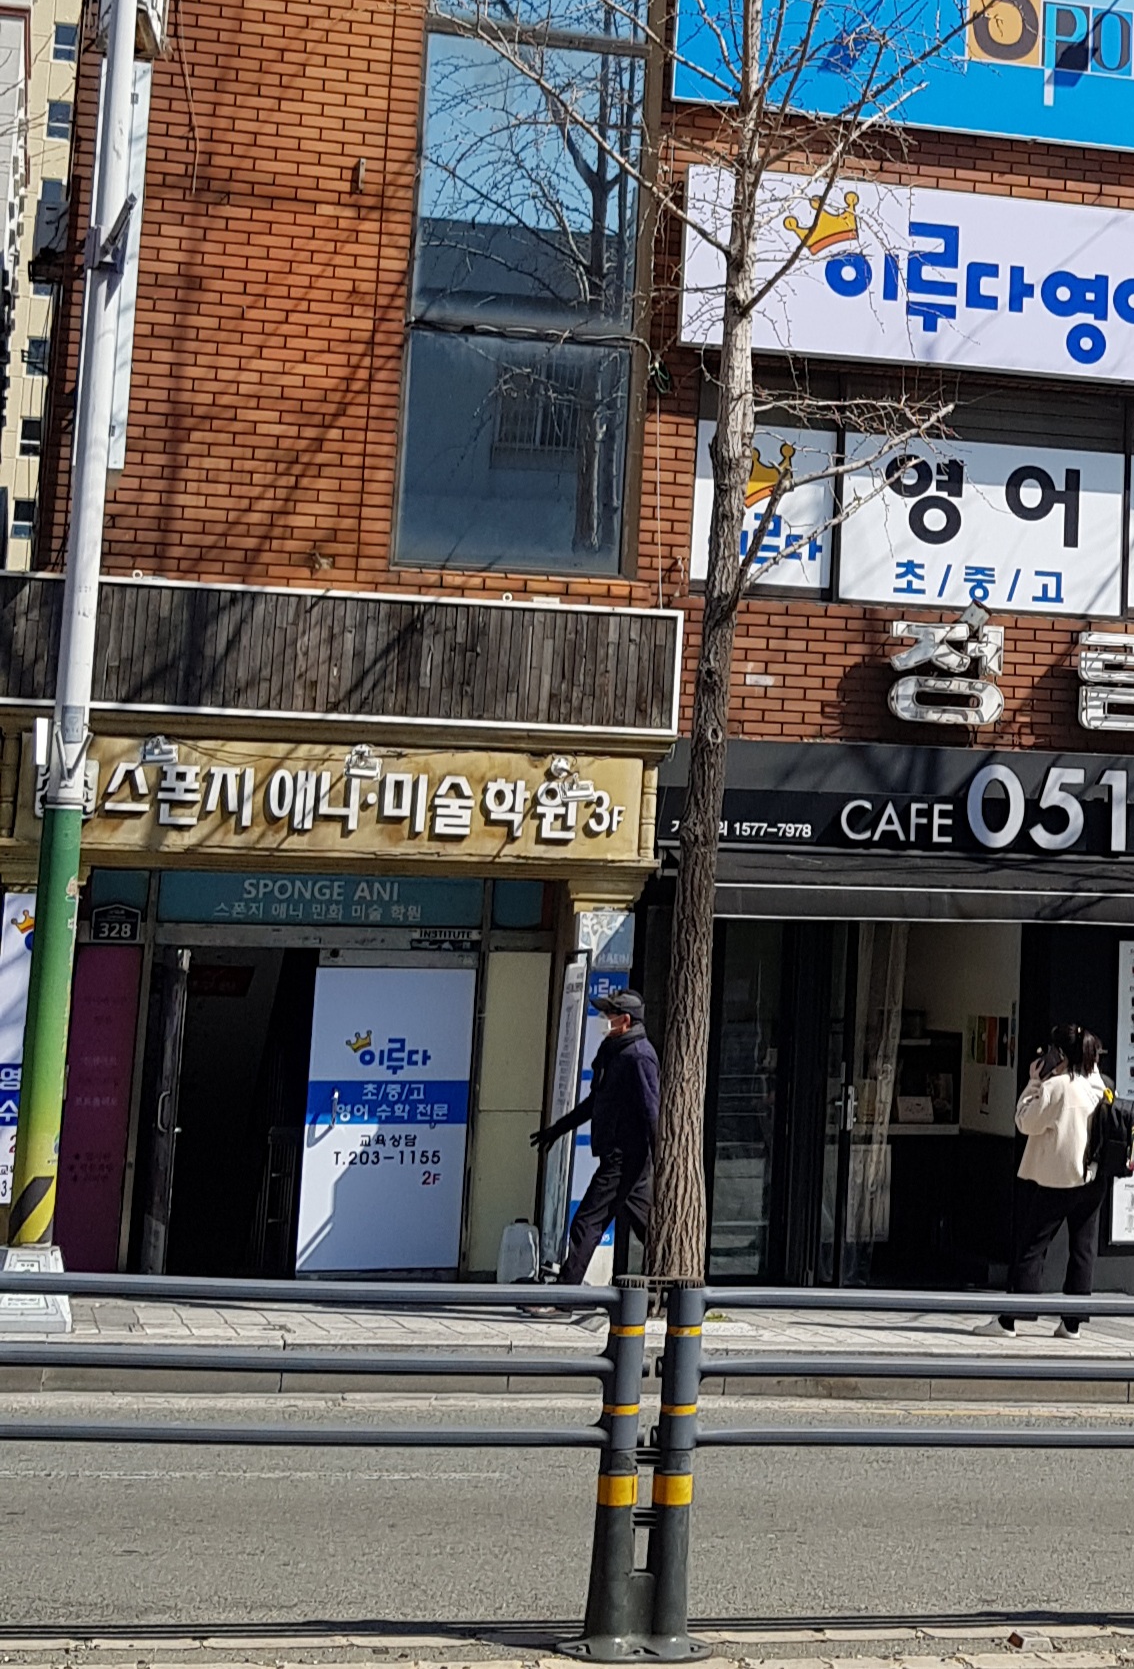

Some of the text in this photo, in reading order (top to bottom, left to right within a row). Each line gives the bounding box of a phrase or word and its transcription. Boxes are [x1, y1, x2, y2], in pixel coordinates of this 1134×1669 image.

[886, 454, 1081, 549] 영어
[105, 761, 253, 829] 스폰지
[588, 789, 626, 832] 3F
[840, 764, 1129, 853] CAFE 051
[733, 821, 812, 838] 1577-7978
[243, 880, 400, 902] SPONGE ANI
[213, 902, 265, 919] 스폰지
[98, 921, 132, 938] 328
[359, 1038, 431, 1075] 이루다
[336, 1103, 448, 1122] 영어 수학 전문
[360, 1133, 417, 1147] 교육상담
[333, 1150, 441, 1166] T.203-1155
[421, 1170, 442, 1186] 2F
